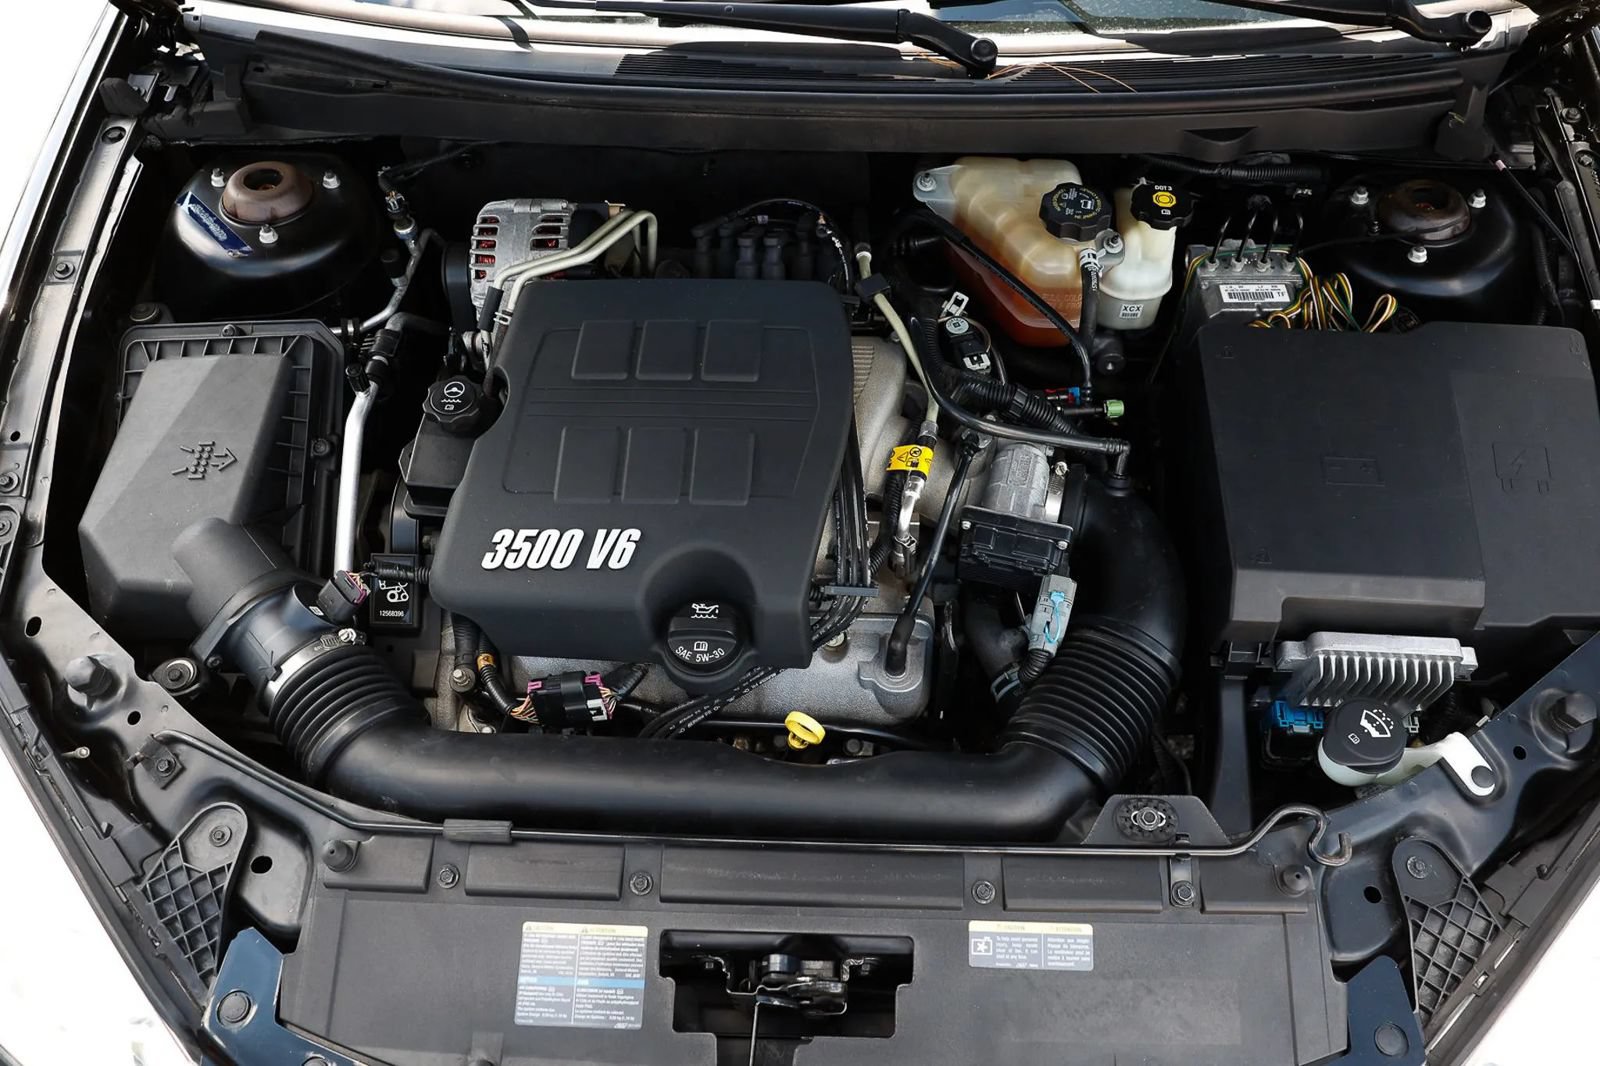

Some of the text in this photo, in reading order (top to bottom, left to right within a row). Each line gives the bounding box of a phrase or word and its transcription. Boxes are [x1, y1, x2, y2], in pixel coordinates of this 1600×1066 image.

[481, 528, 642, 570] 3500 V6
[675, 645, 725, 663] SAE 5W-30
